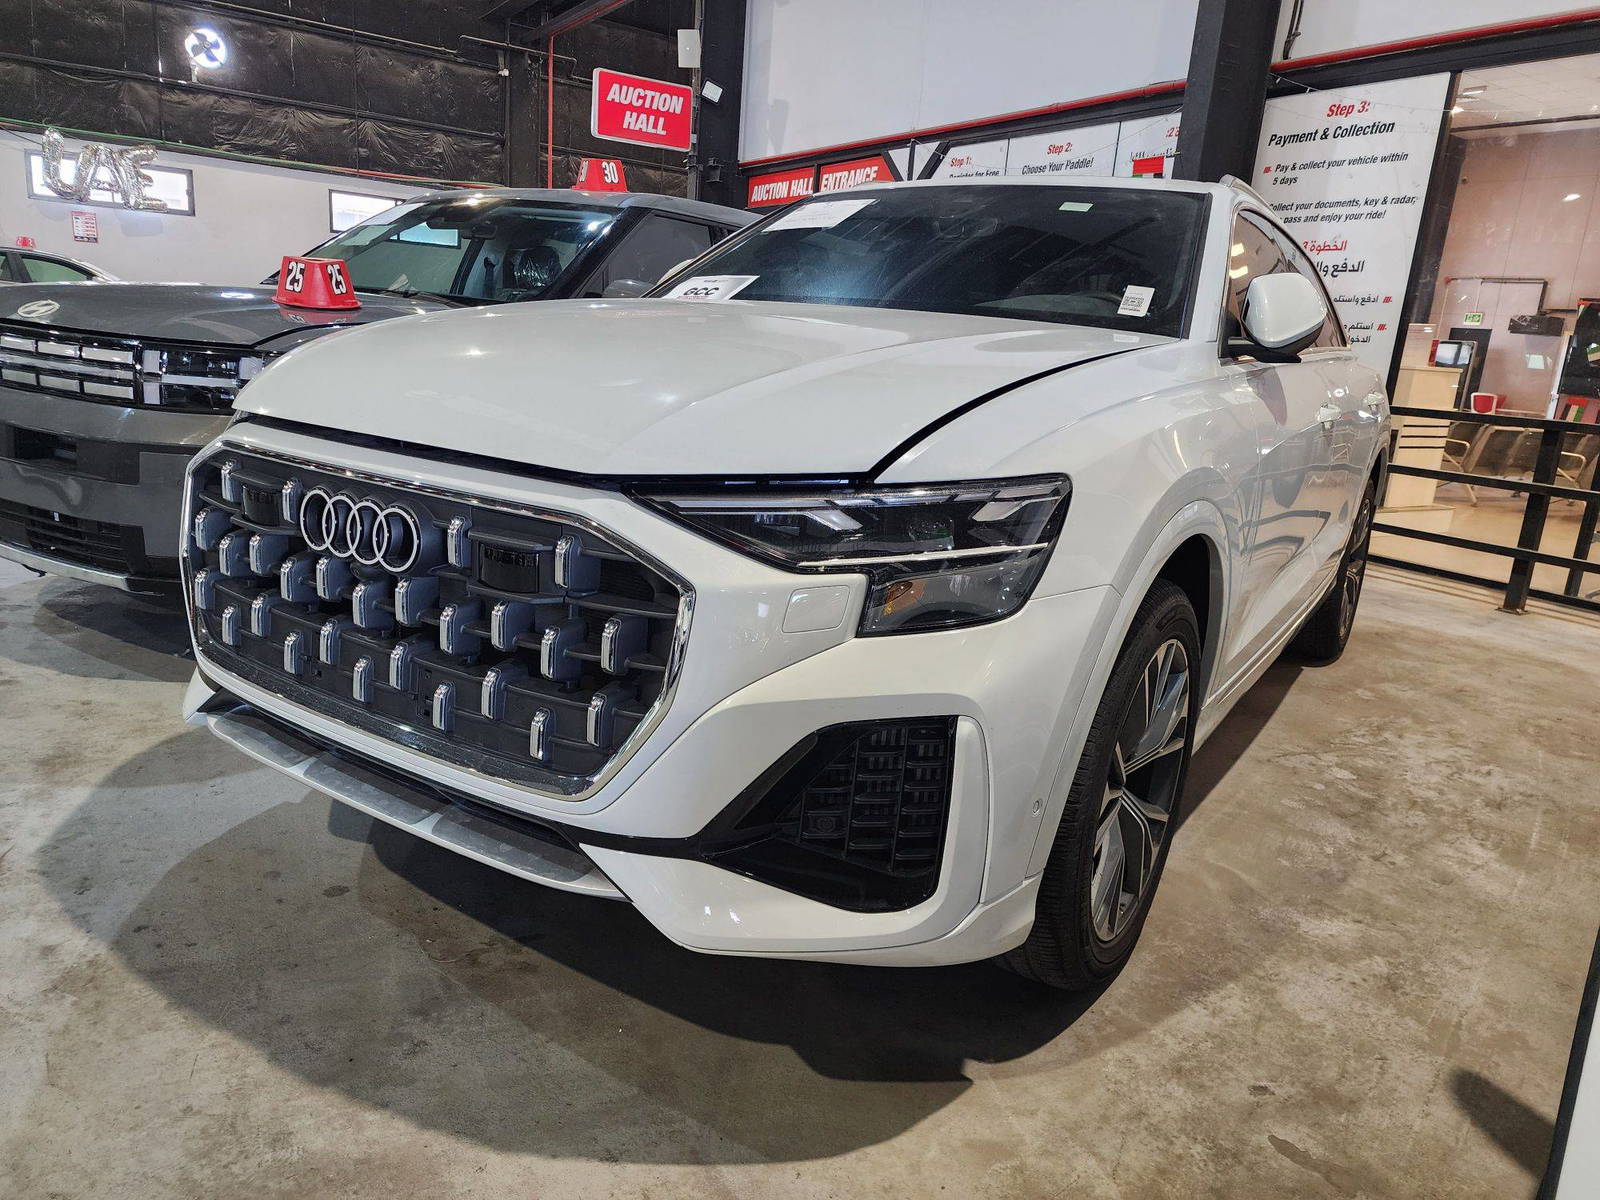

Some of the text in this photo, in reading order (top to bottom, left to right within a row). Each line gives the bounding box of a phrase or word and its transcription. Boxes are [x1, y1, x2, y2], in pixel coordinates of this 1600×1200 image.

[606, 83, 684, 115] AUCTION
[1327, 100, 1371, 118] Step 3:
[623, 110, 667, 135] HALL
[1268, 121, 1396, 148] Payment & Collection
[1047, 142, 1073, 155] Step 2:
[41, 127, 168, 212] UAE
[602, 161, 619, 183] 30
[950, 157, 964, 168] Step
[1022, 157, 1094, 176] Choose Your Paddle!
[1275, 152, 1409, 175] Pay & collect your vehicle within
[751, 181, 789, 202] AUCTION
[790, 177, 814, 197] HALL
[1273, 175, 1298, 187] 5 days
[1294, 202, 1313, 213] your
[1314, 198, 1361, 210] documents,
[1363, 197, 1379, 207] key
[1381, 196, 1388, 205] &
[1390, 195, 1416, 205] radar,
[1304, 213, 1318, 222] and
[1320, 213, 1343, 223] enjoy
[1344, 212, 1363, 222] your
[1365, 210, 1386, 220] ride!
[1310, 240, 1348, 255] الخطوة
[285, 261, 305, 292] 25
[1331, 258, 1366, 278] الدفع
[327, 264, 347, 295] 25
[684, 287, 719, 295] GCC
